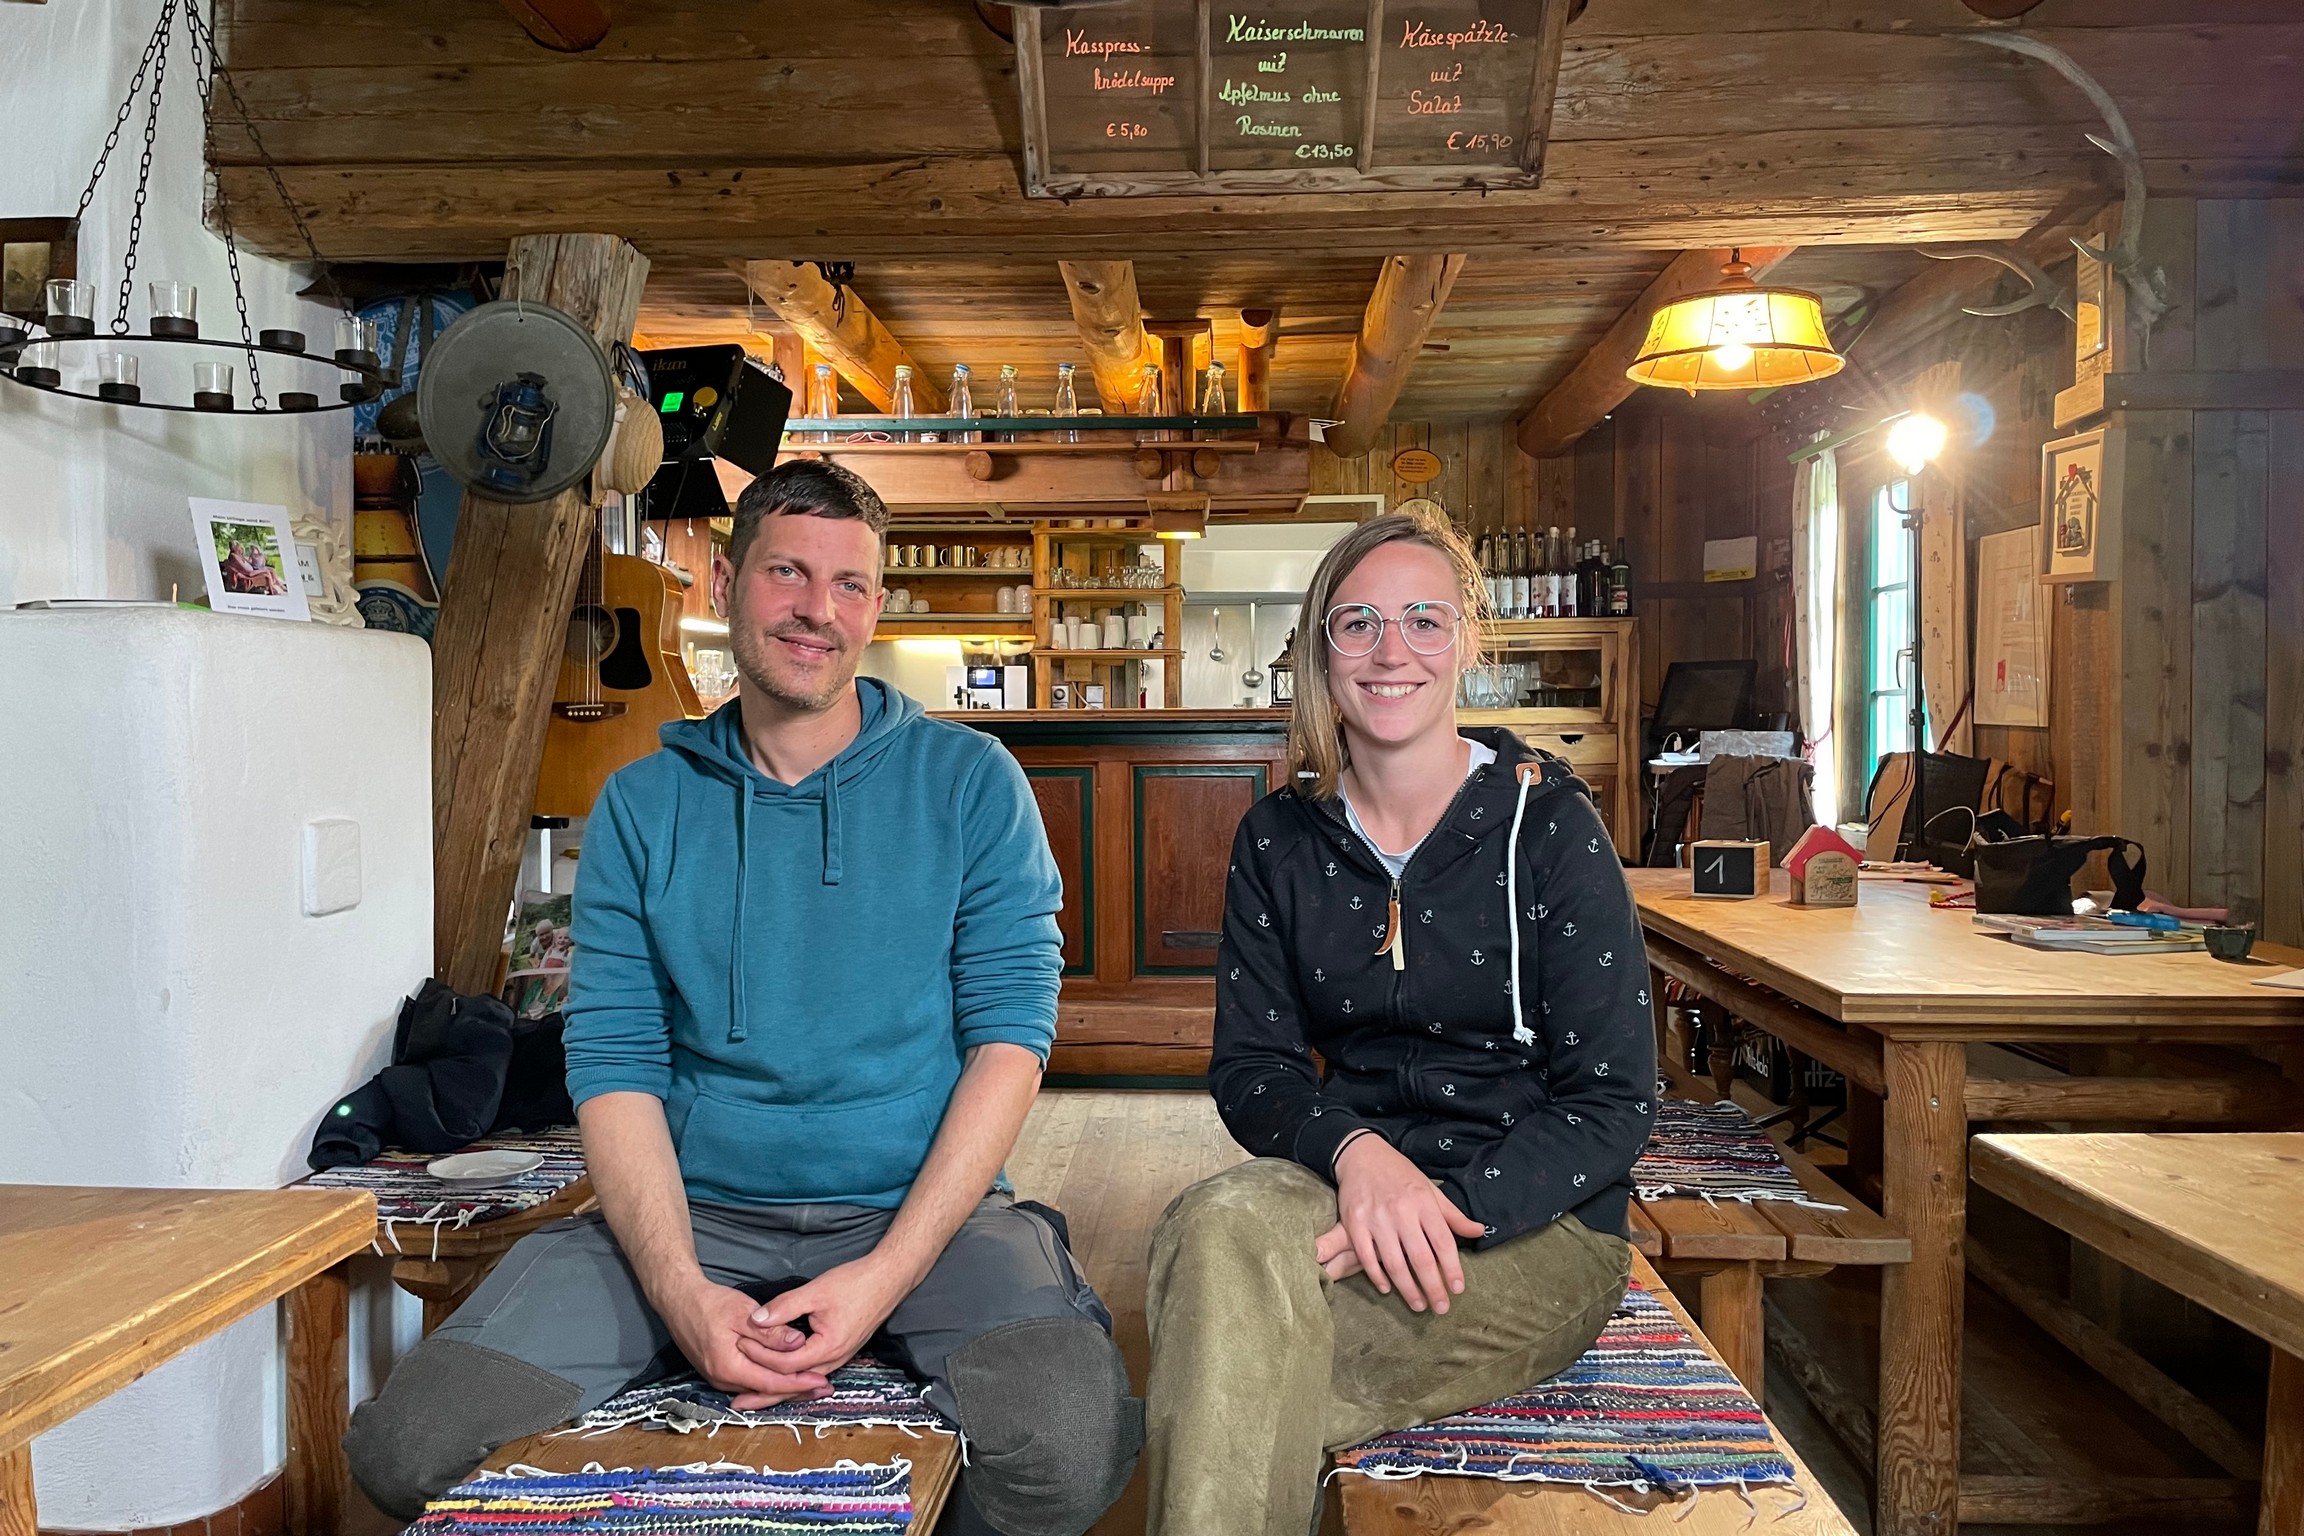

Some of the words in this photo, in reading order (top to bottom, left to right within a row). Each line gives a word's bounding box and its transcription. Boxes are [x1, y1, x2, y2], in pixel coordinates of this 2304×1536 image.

[1226, 14, 1365, 43] Kaiserschmarren
[1258, 52, 1287, 73] mit
[1430, 62, 1462, 82] mit
[1218, 79, 1291, 107] Apfelmus
[1302, 85, 1342, 103] ohne
[1407, 90, 1462, 114] Salat
[1235, 115, 1303, 137] Rosinen
[652, 358, 687, 372] ikan
[1704, 853, 1724, 885] 1
